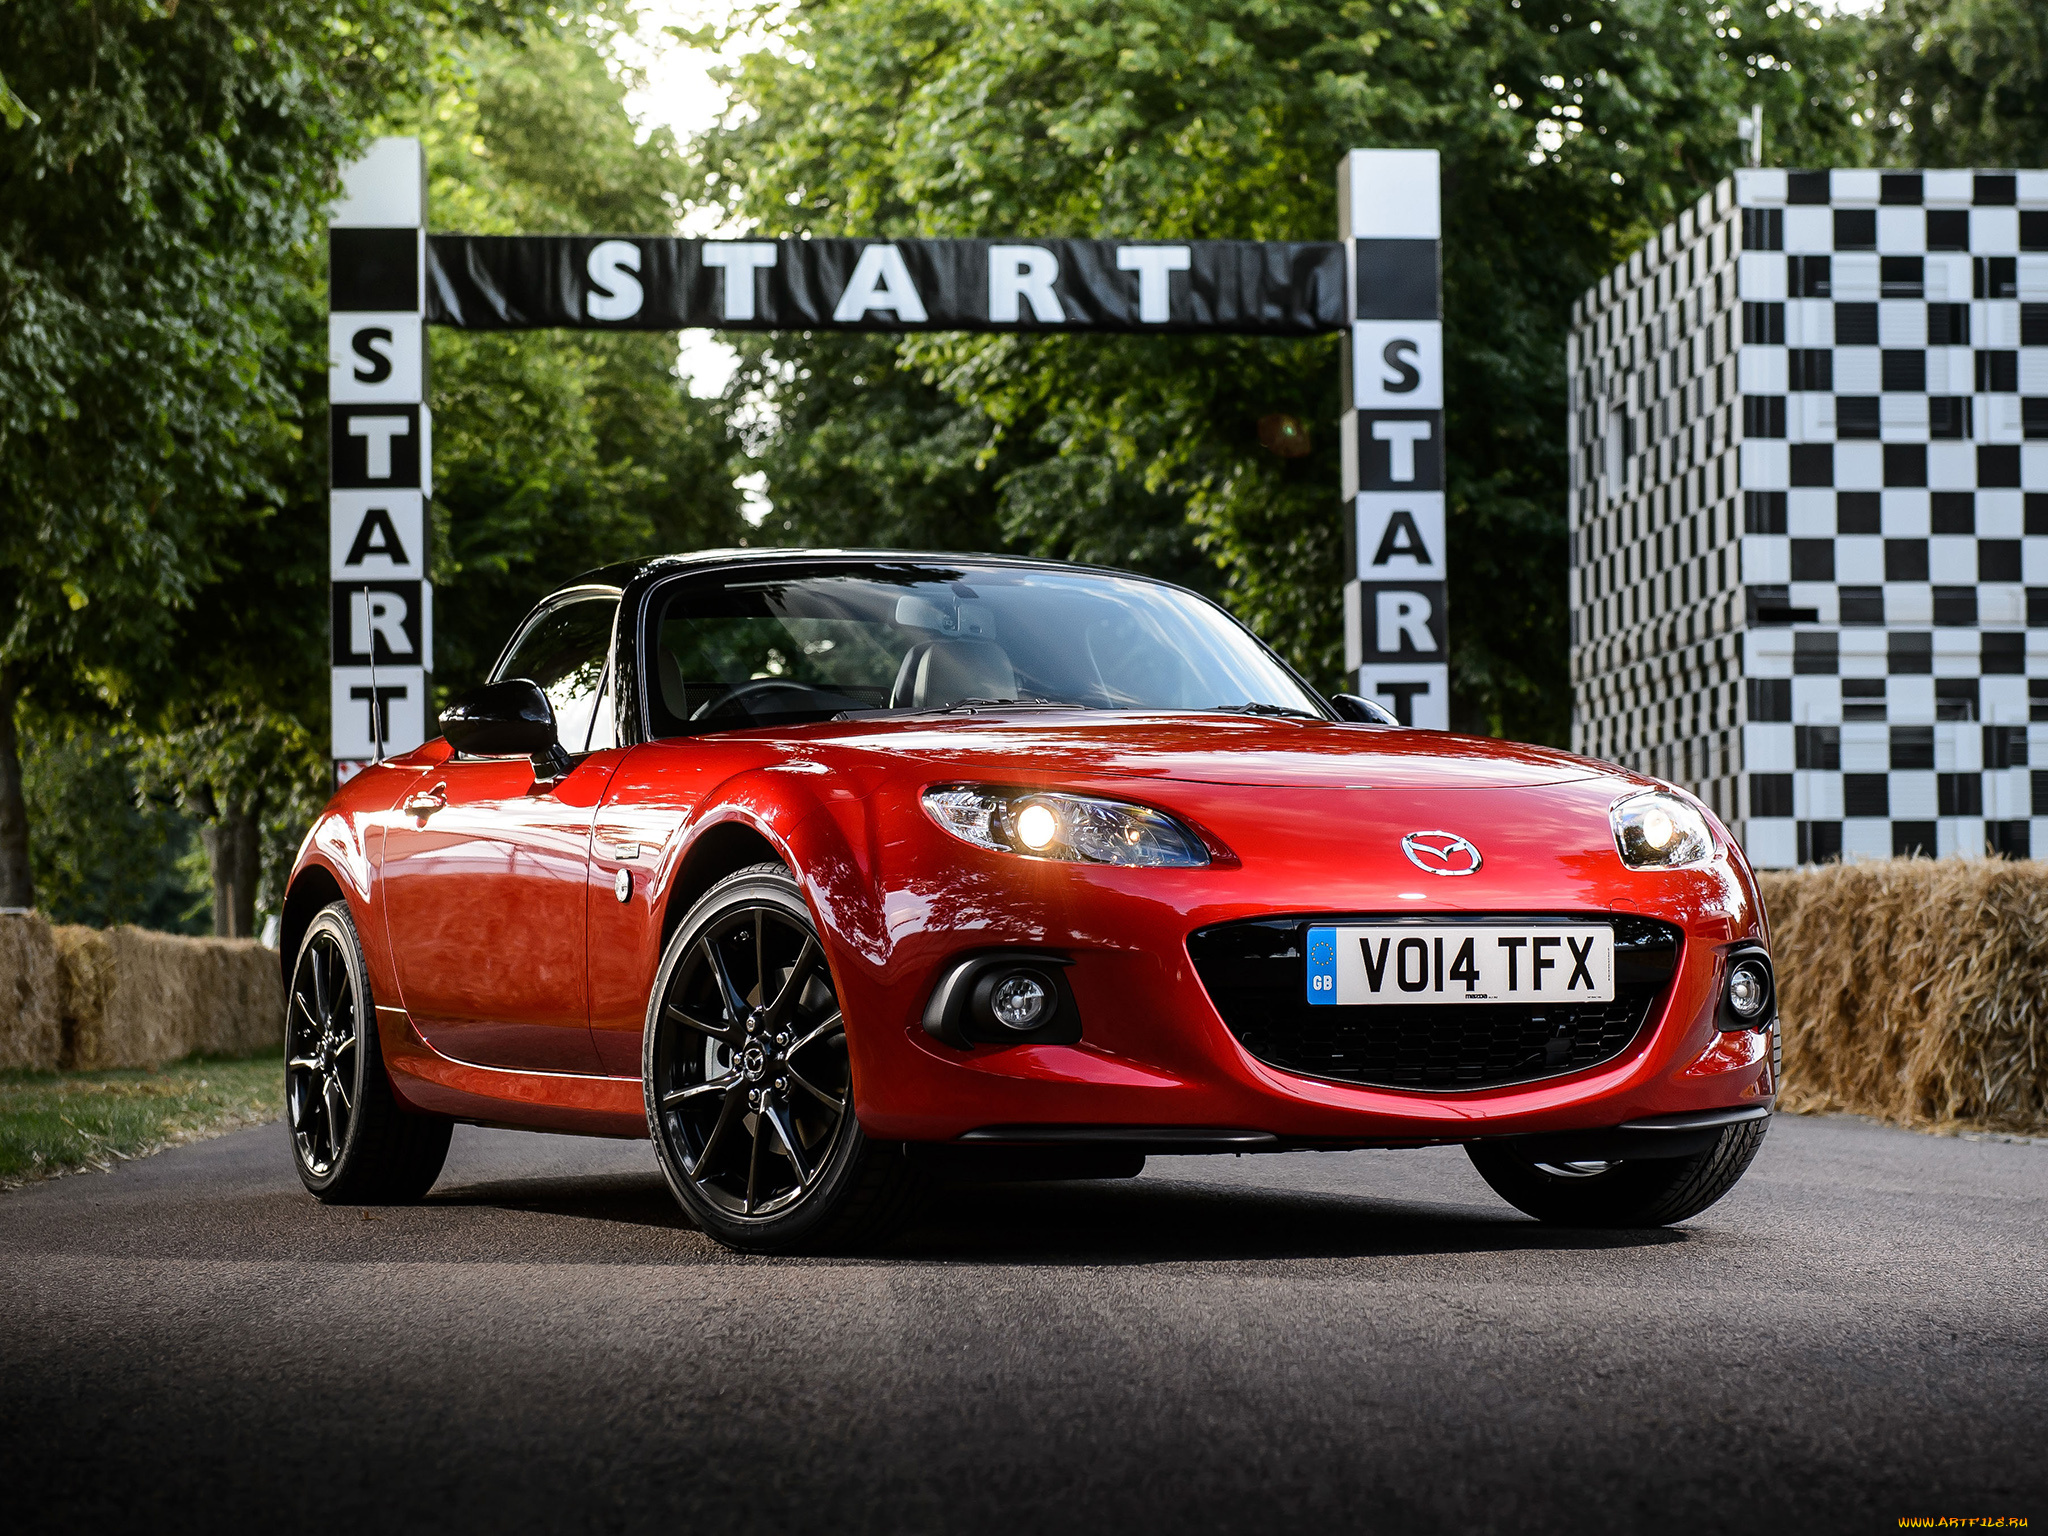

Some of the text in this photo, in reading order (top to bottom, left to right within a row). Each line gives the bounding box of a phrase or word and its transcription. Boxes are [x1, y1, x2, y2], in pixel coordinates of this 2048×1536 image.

[586, 240, 1192, 323] START
[344, 326, 412, 744] START
[1372, 339, 1437, 728] START
[1313, 975, 1332, 991] GB
[1359, 937, 1480, 993] VO14
[1497, 936, 1595, 991] TFX
